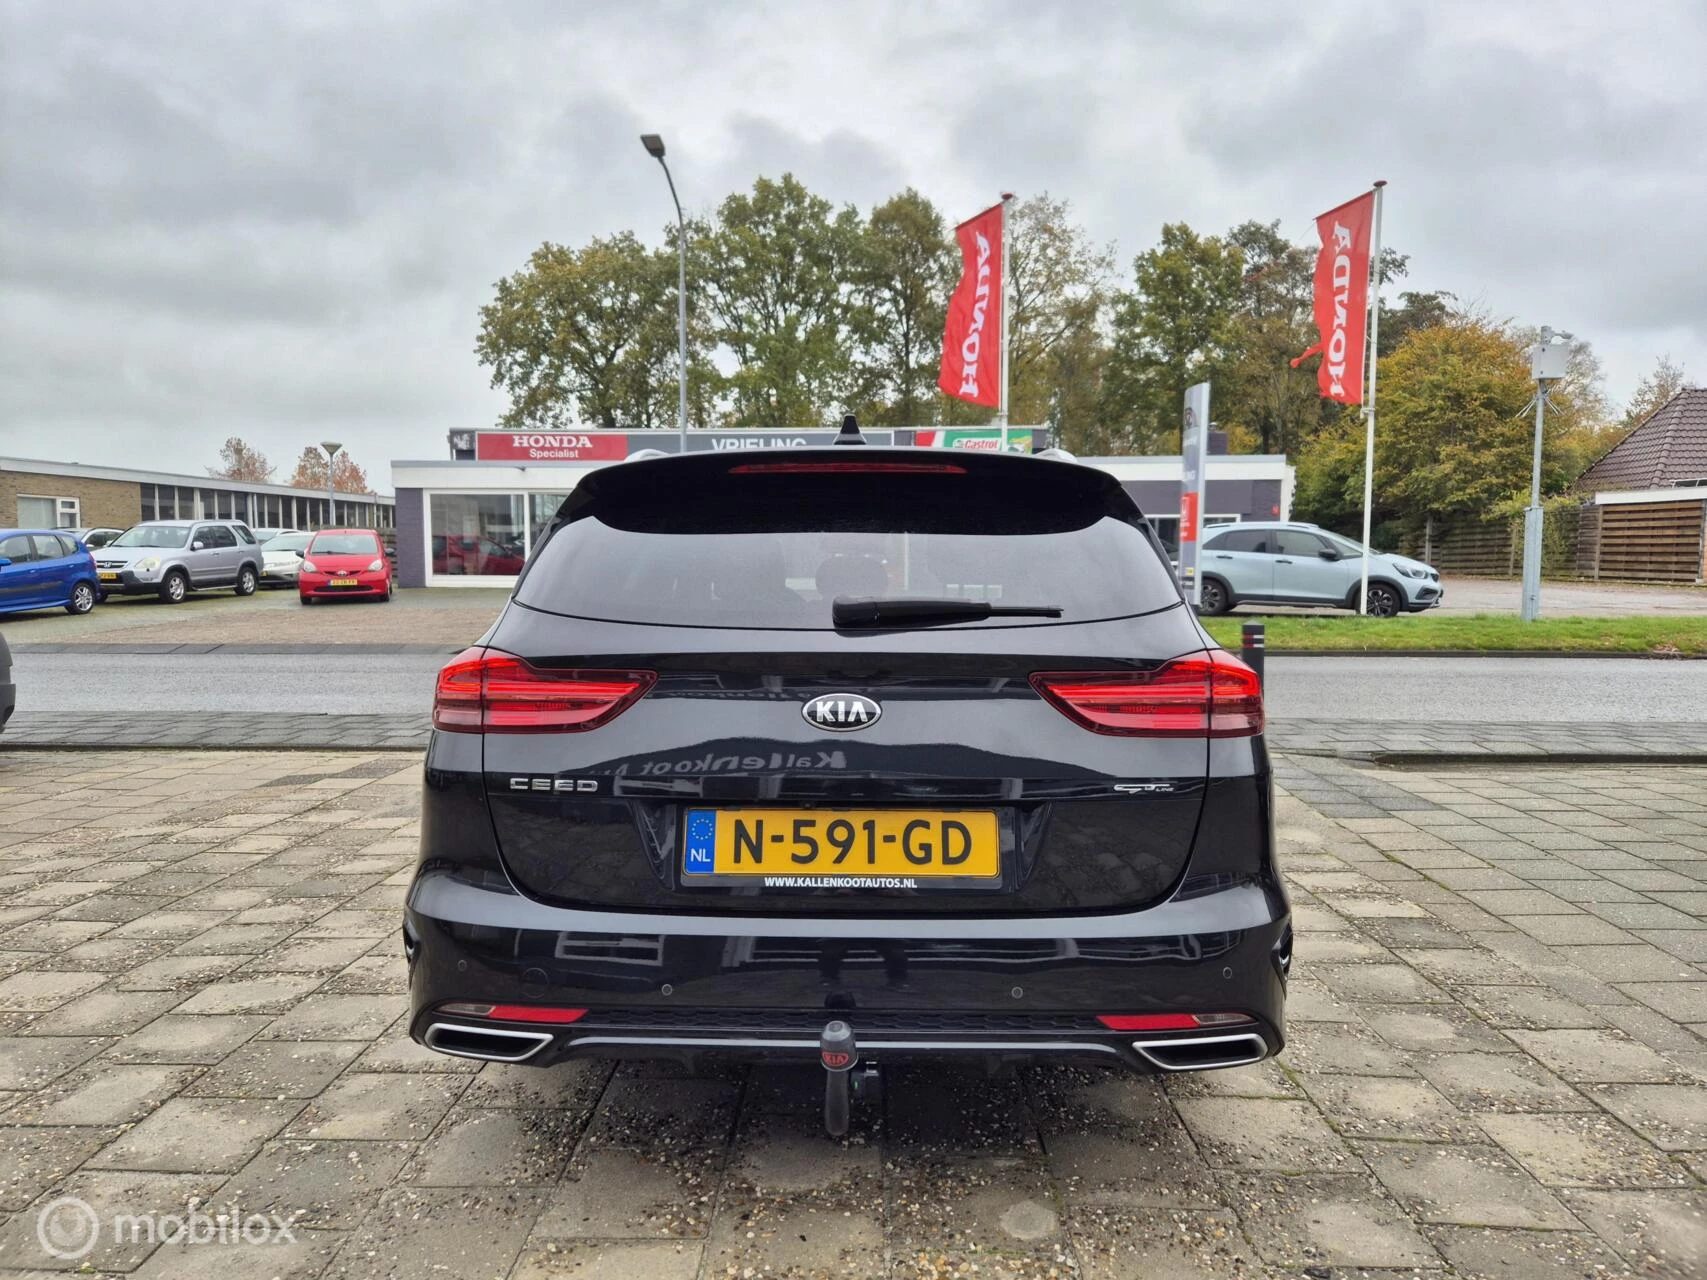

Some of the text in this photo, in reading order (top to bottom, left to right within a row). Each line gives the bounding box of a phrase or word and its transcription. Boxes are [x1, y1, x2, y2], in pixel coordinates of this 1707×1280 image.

[512, 435, 593, 448] HONDA
[964, 439, 998, 450] Castrol
[529, 448, 579, 459] Specialist
[815, 700, 869, 723] KIA
[510, 778, 598, 792] CEED
[733, 819, 972, 865] N-591-GD
[690, 848, 711, 862] NL
[764, 877, 917, 889] WWW.KALLENKOOTAUTOS.NL
